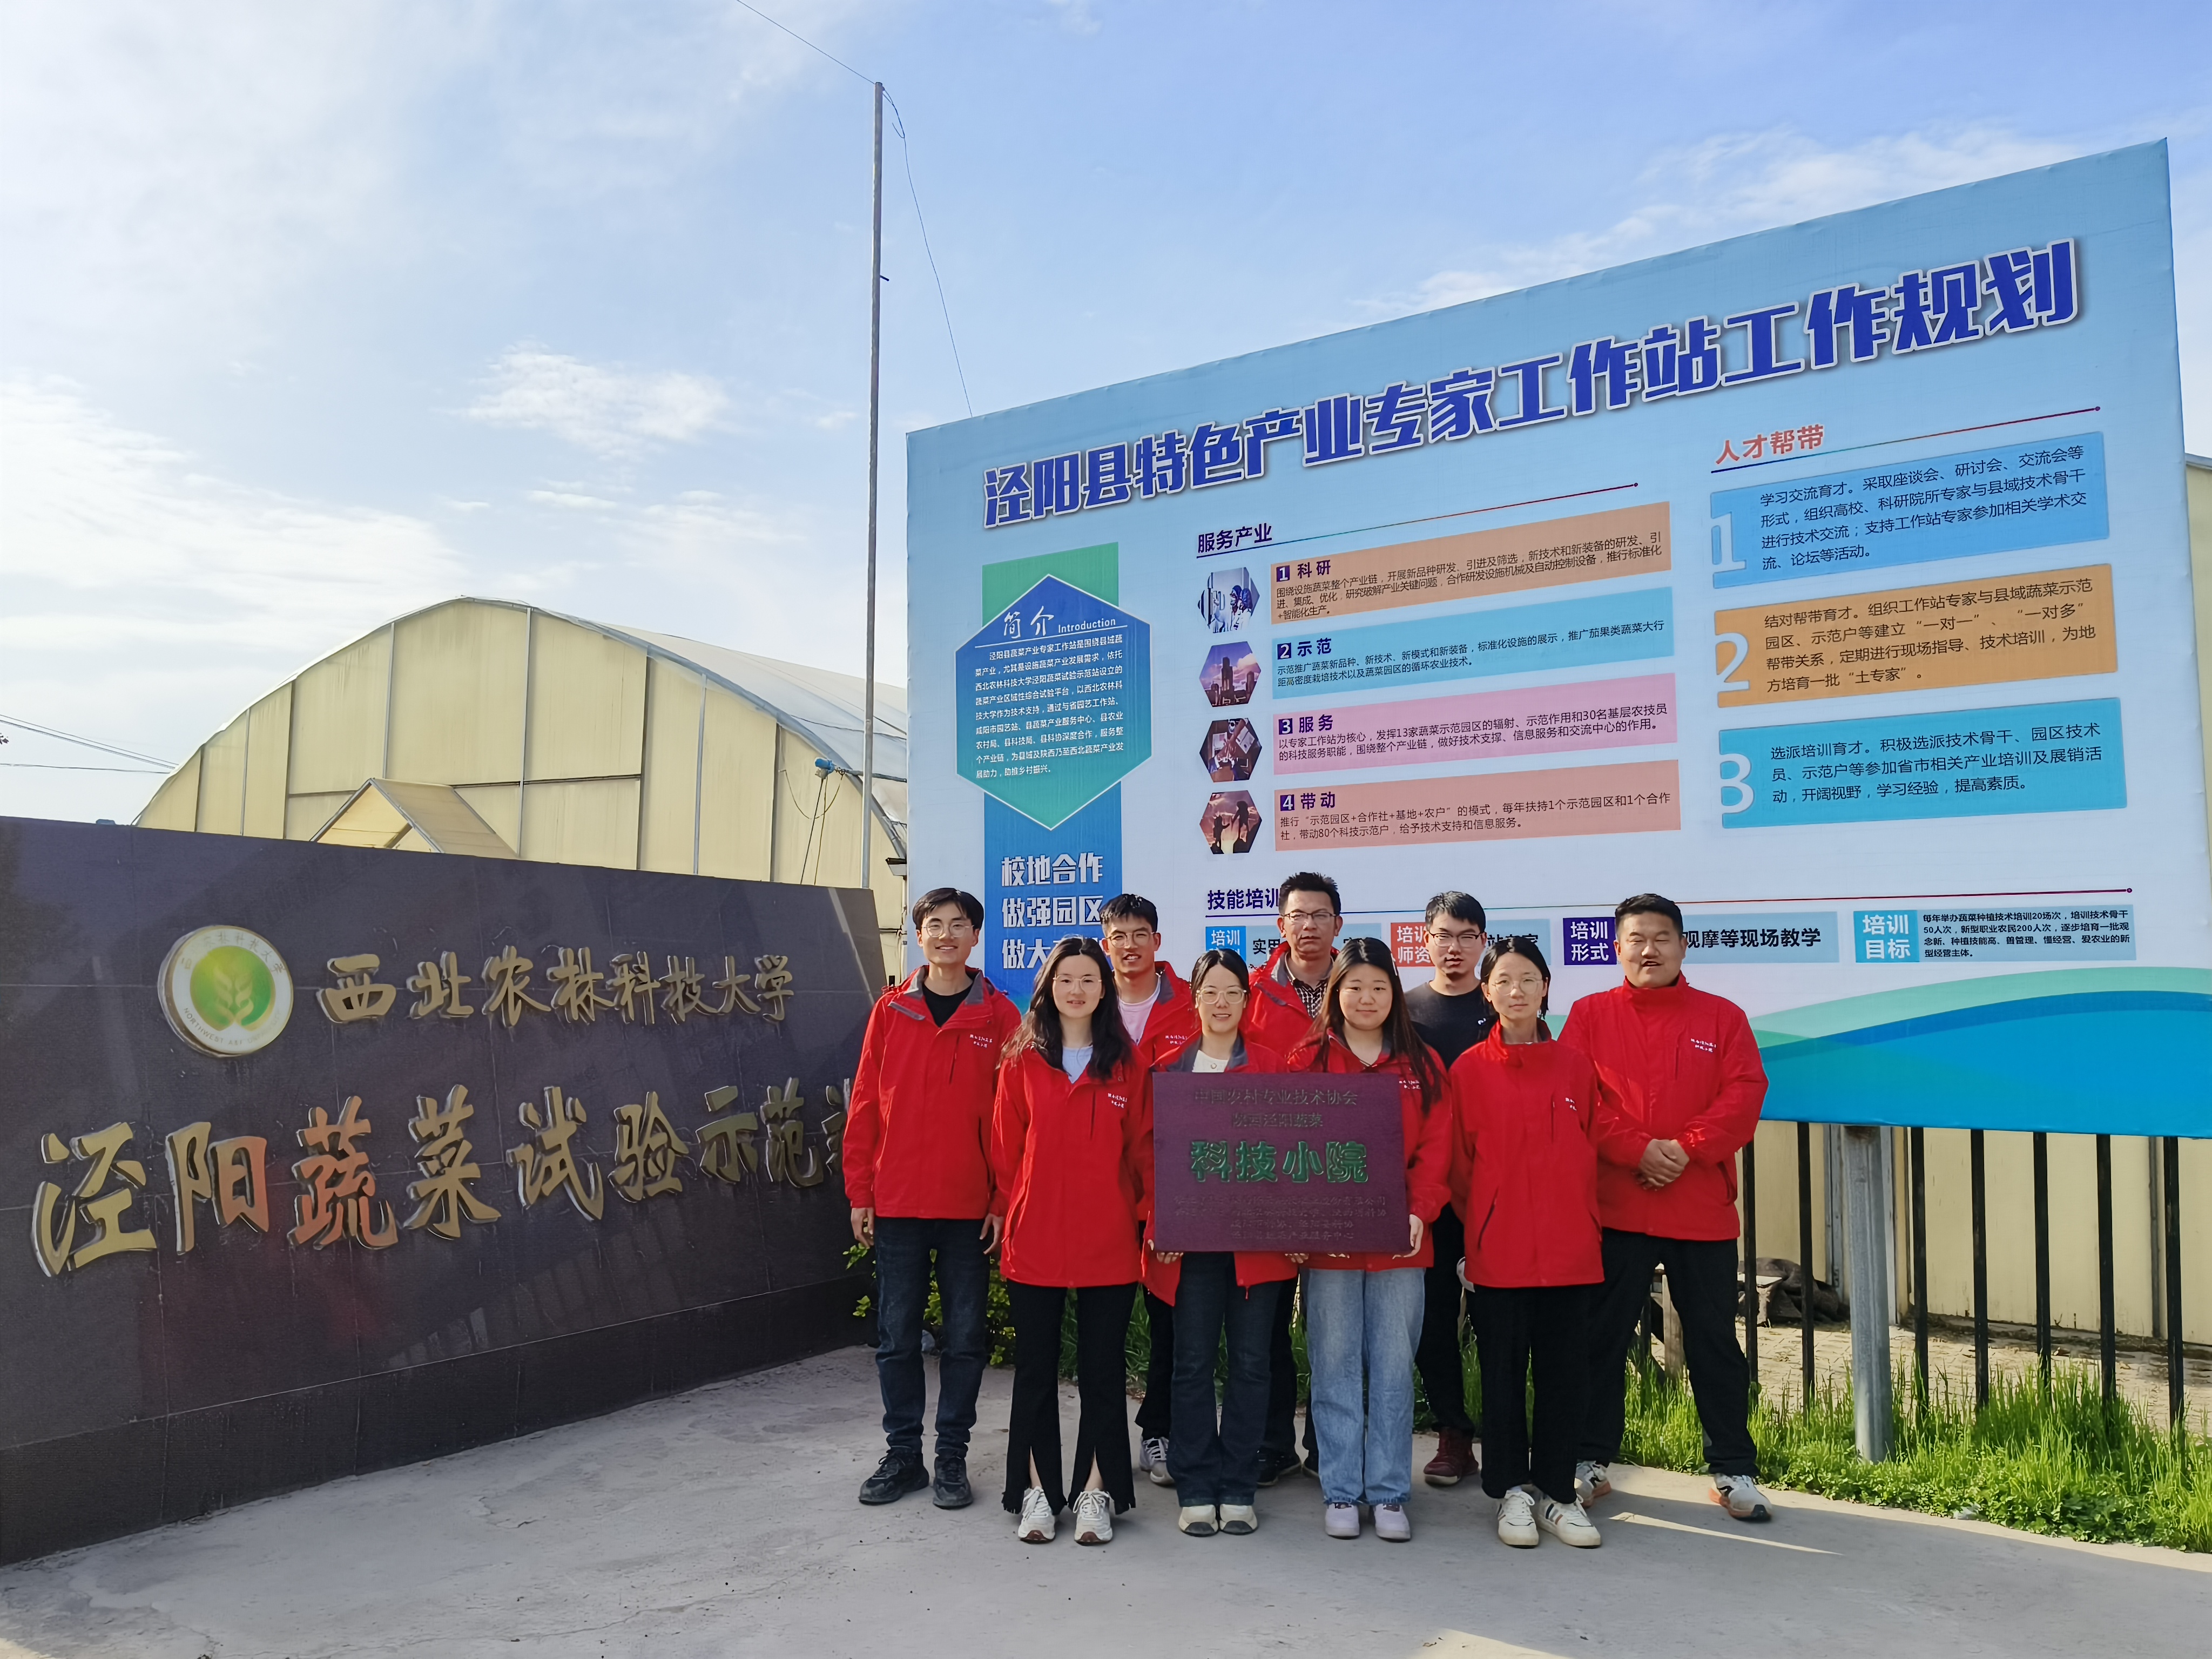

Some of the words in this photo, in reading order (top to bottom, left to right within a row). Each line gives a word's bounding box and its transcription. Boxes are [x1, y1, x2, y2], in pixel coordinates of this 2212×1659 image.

[983, 235, 2083, 531] 泾阳县特色产业专家工作站工作规划
[1715, 424, 1825, 464] 人才帮带
[1198, 522, 1272, 554] 服务产业
[1297, 559, 1331, 579] 科研
[1762, 544, 1871, 571] 流、论坛等活动。
[1003, 605, 1054, 639] 简介
[1058, 618, 1116, 633] Introduction
[1297, 638, 1332, 657] 示范
[1716, 632, 1750, 692] 2
[1299, 714, 1333, 733] 服务
[1721, 752, 1754, 813] 3
[1300, 792, 1335, 810] 带动
[1001, 852, 1103, 887] 校地合作
[1002, 895, 1103, 928] 做强园区
[1570, 921, 1608, 940] 培训
[1863, 914, 1908, 935] 培训
[1211, 929, 1240, 946] 培训
[1682, 928, 1821, 948] 观摩等现场教学
[1866, 939, 1911, 959] 目标
[1398, 946, 1431, 964] 师资
[1571, 943, 1609, 961] 形式
[318, 944, 795, 1026] 西北农林科技大学
[1190, 1140, 1369, 1183] 科技小院
